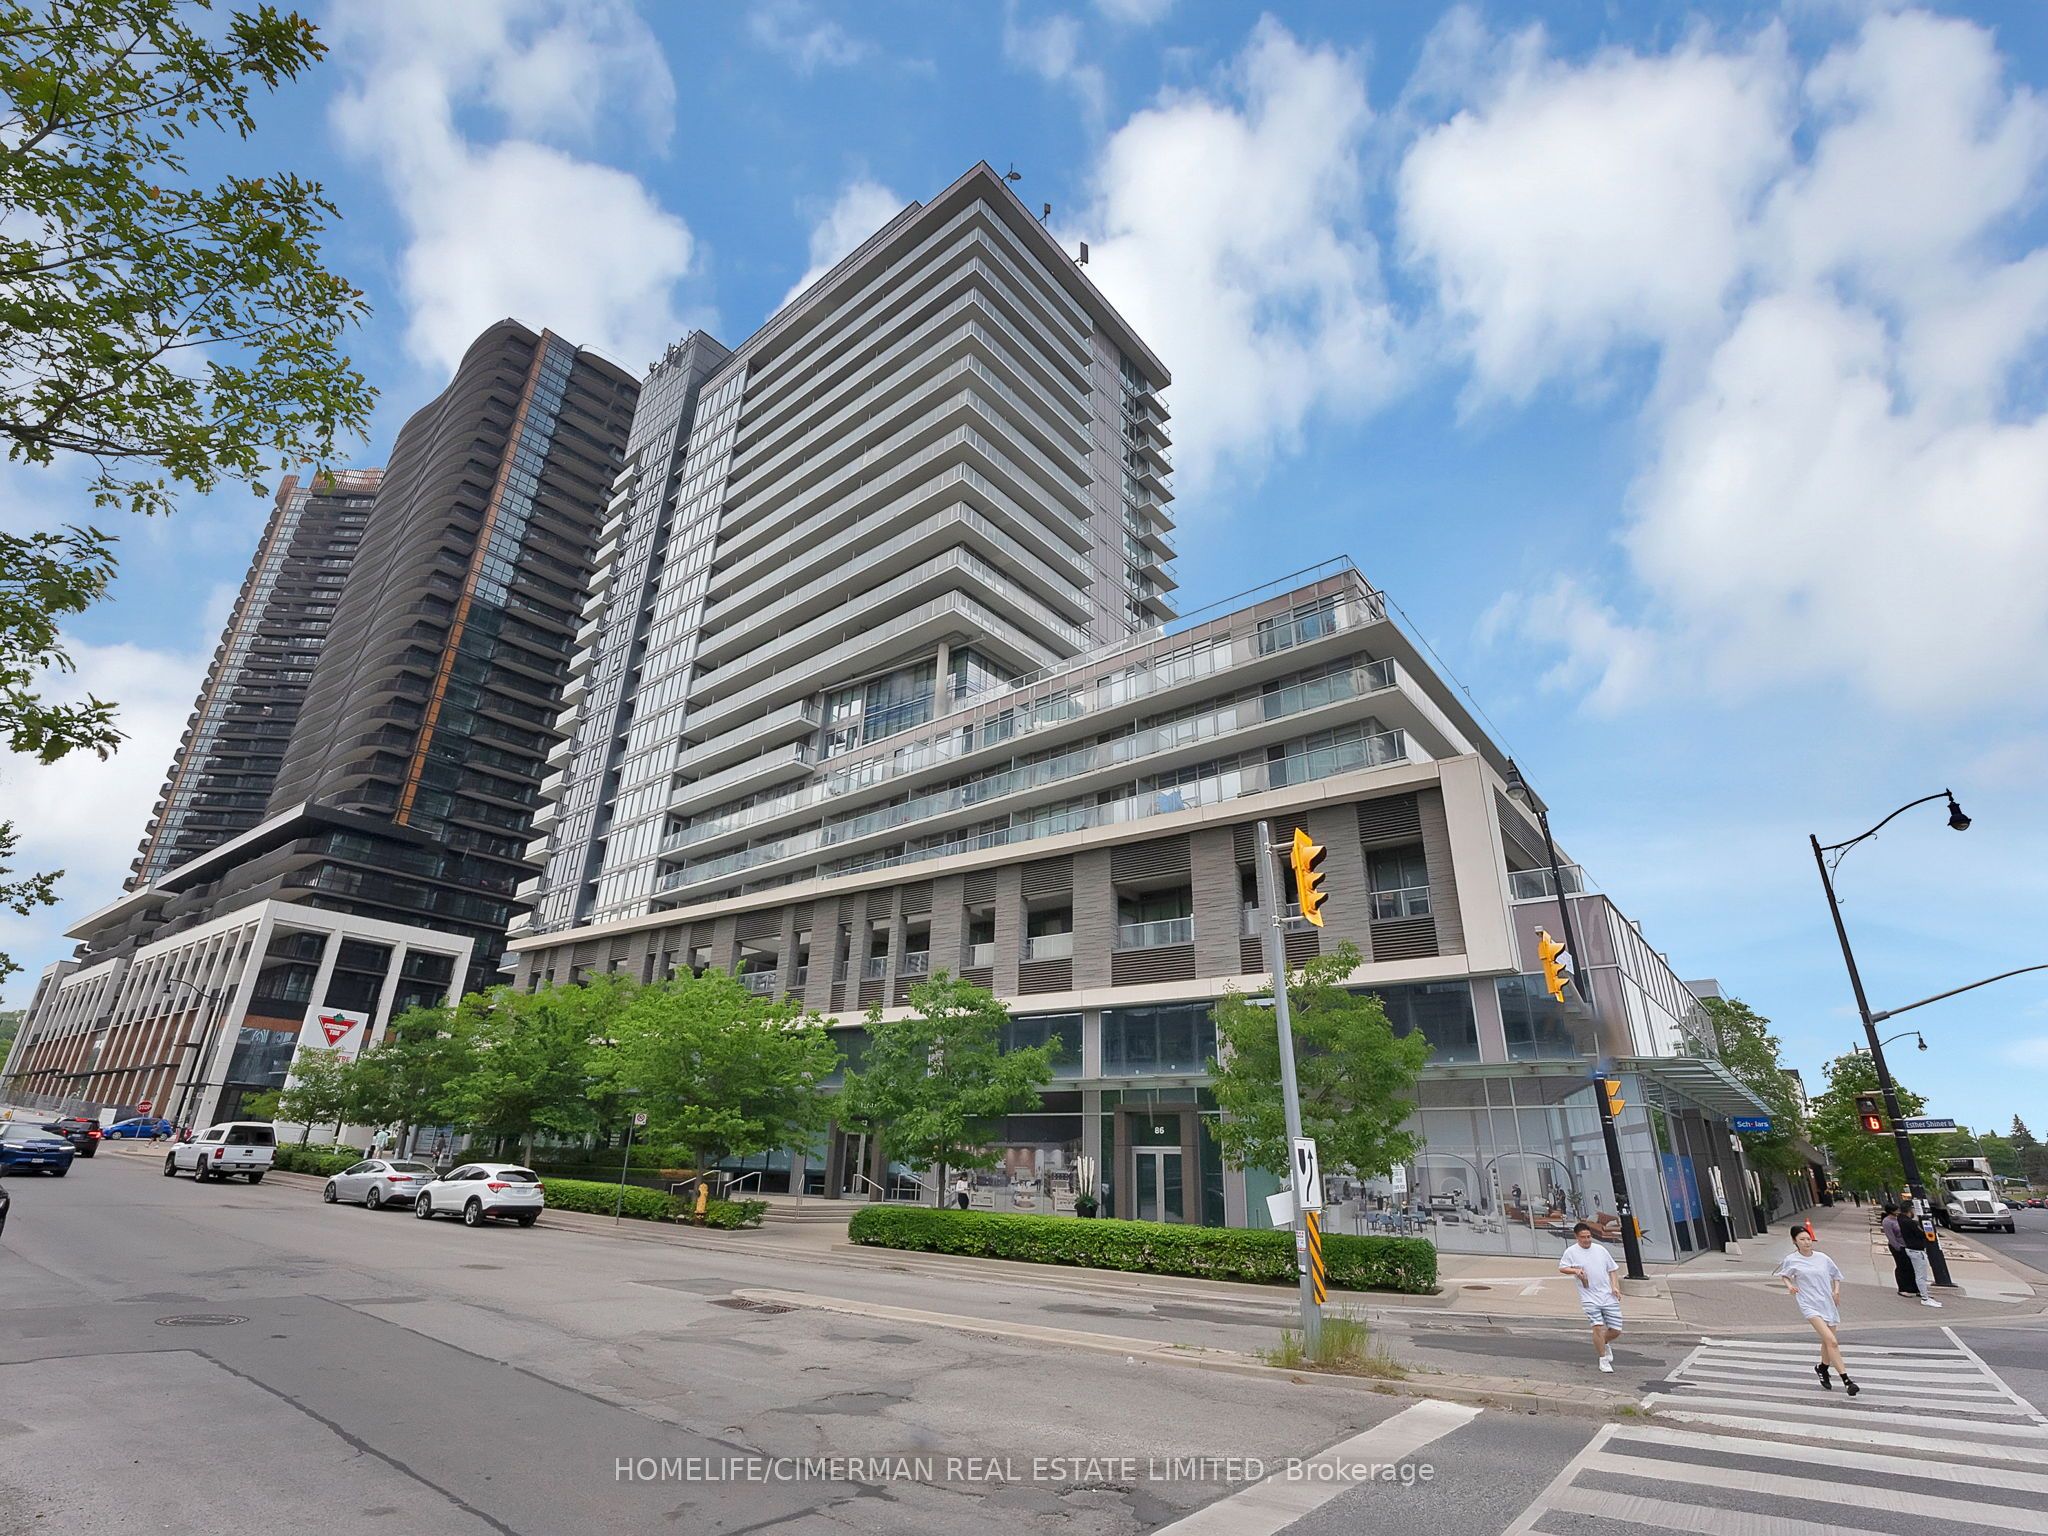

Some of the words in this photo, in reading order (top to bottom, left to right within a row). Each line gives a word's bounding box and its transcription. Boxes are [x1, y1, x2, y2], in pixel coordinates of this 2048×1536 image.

[1905, 1121, 1926, 1129] Esther
[1926, 1120, 1947, 1128] Shiner
[1154, 1126, 1165, 1135] 86
